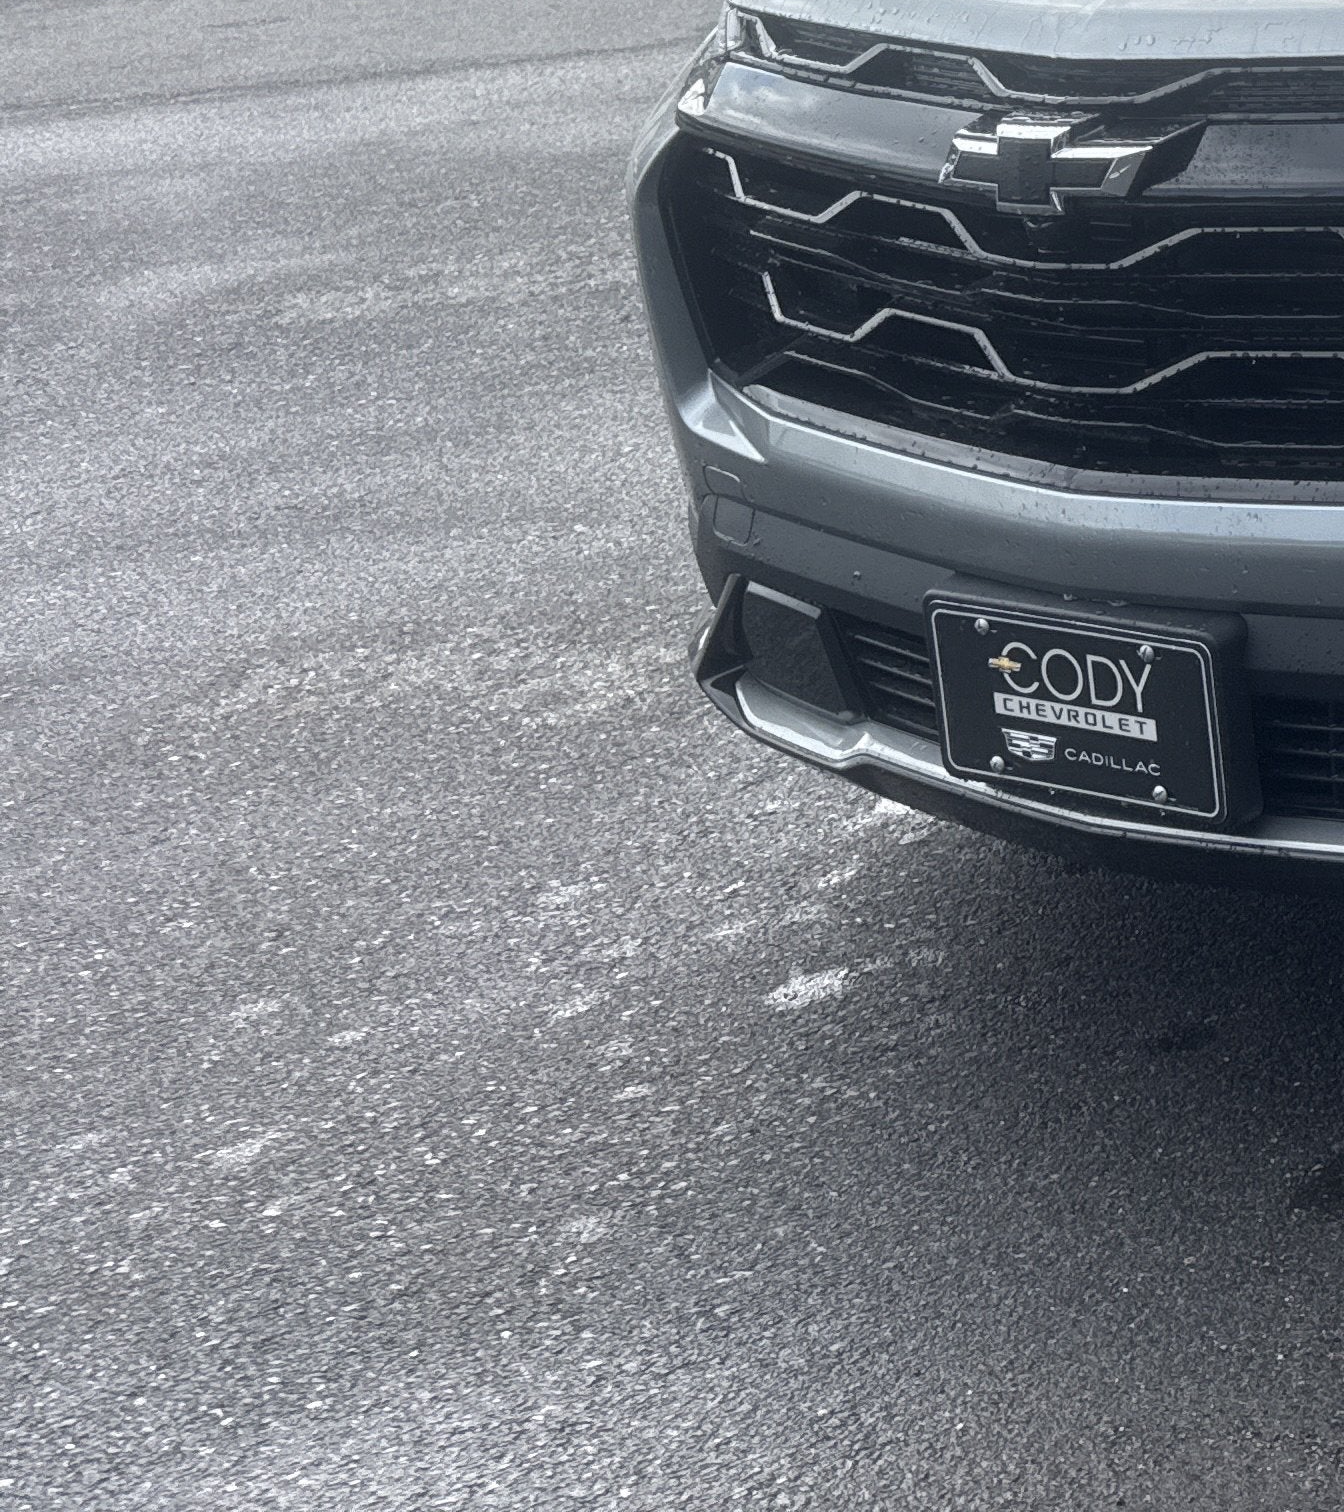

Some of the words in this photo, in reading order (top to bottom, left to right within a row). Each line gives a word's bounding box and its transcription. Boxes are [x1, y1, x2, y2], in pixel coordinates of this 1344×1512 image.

[1001, 641, 1151, 714] CODY
[1003, 697, 1148, 736] CHEVROLET
[1064, 747, 1162, 777] CADILLAC
